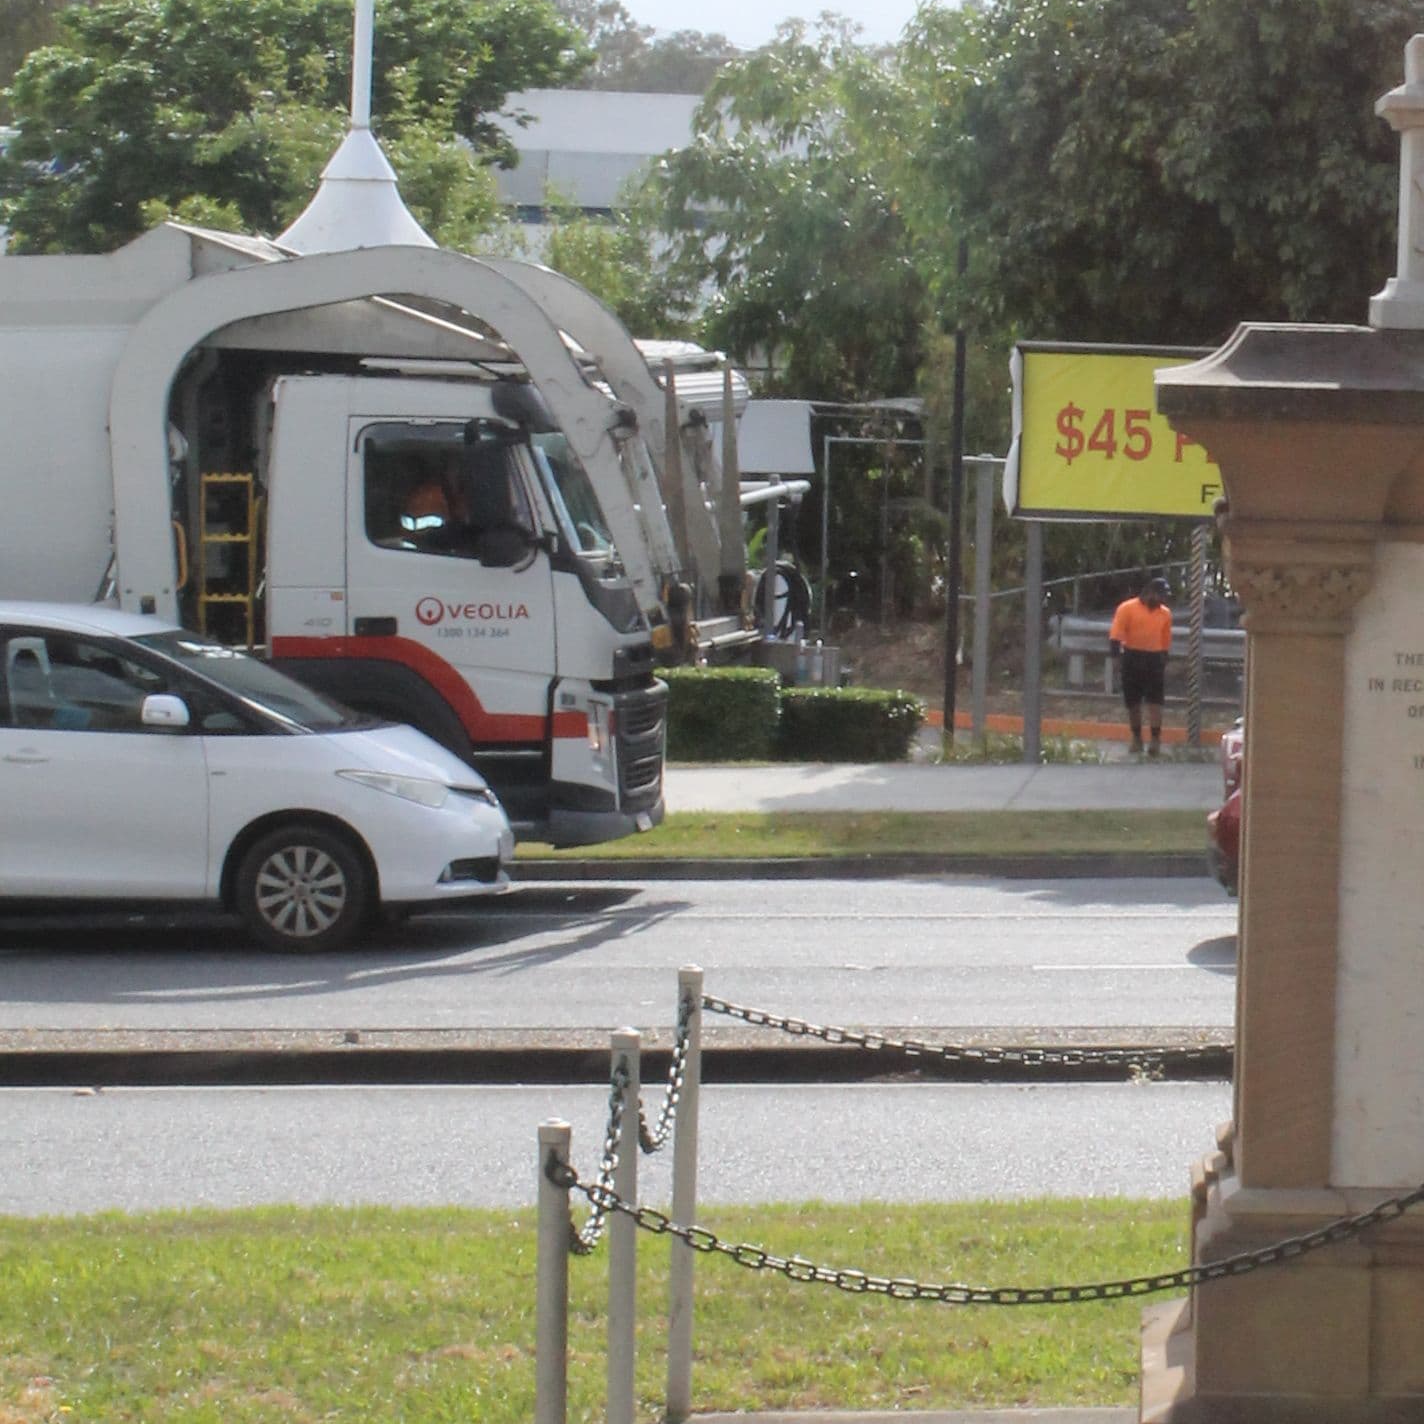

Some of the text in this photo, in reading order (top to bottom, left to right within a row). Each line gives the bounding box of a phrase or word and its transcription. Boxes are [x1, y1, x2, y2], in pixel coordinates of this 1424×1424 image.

[1055, 401, 1153, 466] $45
[447, 603, 530, 620] VEOLIA
[1368, 678, 1386, 693] IN
